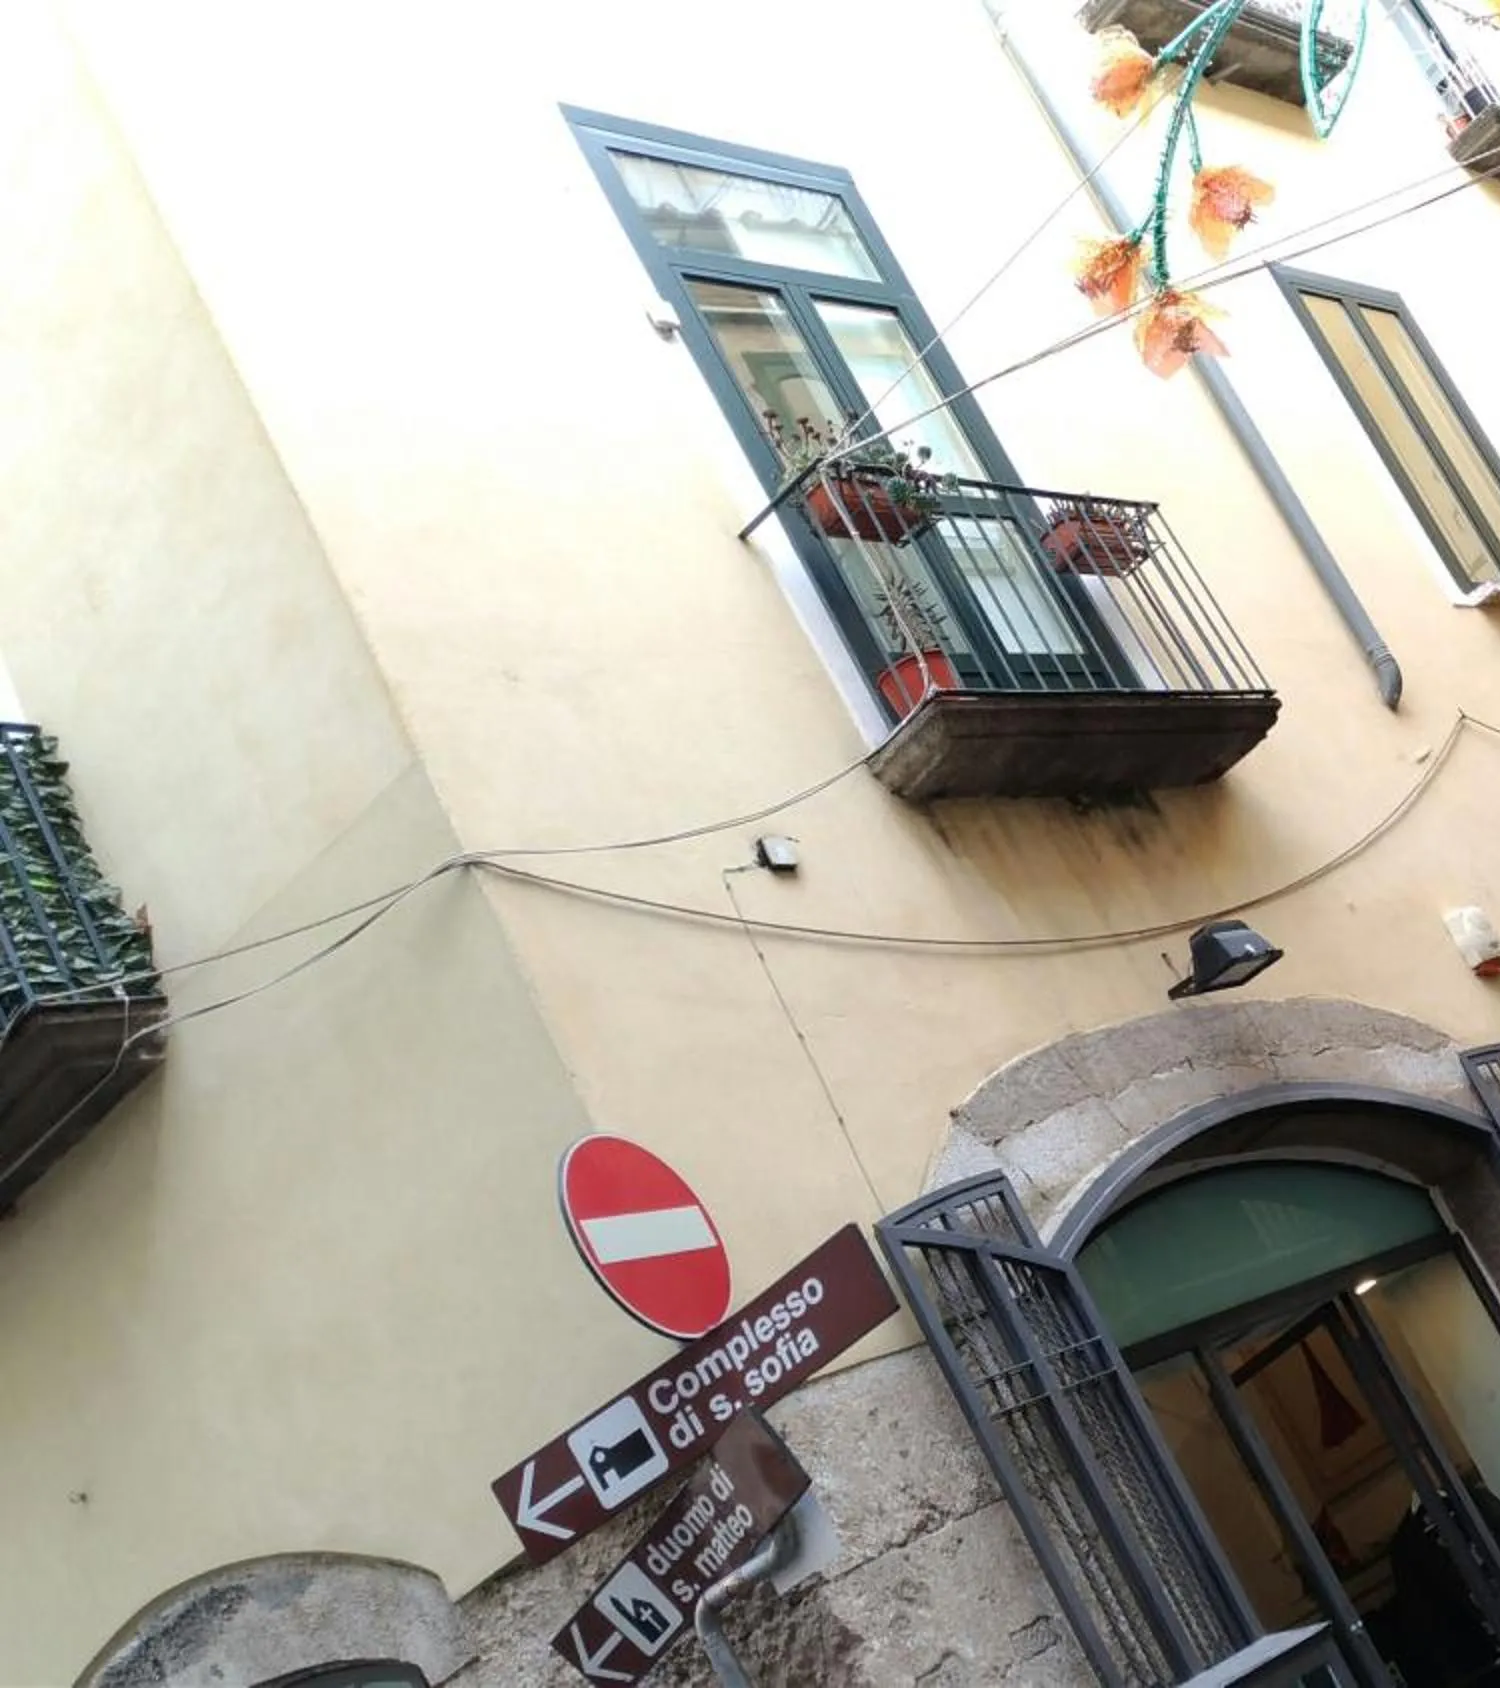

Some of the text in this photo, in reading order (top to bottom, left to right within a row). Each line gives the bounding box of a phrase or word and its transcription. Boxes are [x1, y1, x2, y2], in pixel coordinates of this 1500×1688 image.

[648, 1277, 824, 1415] Complesso
[669, 1327, 820, 1449] di s. sofia
[647, 1463, 735, 1576] duomo di
[671, 1503, 753, 1603] s. matteo
